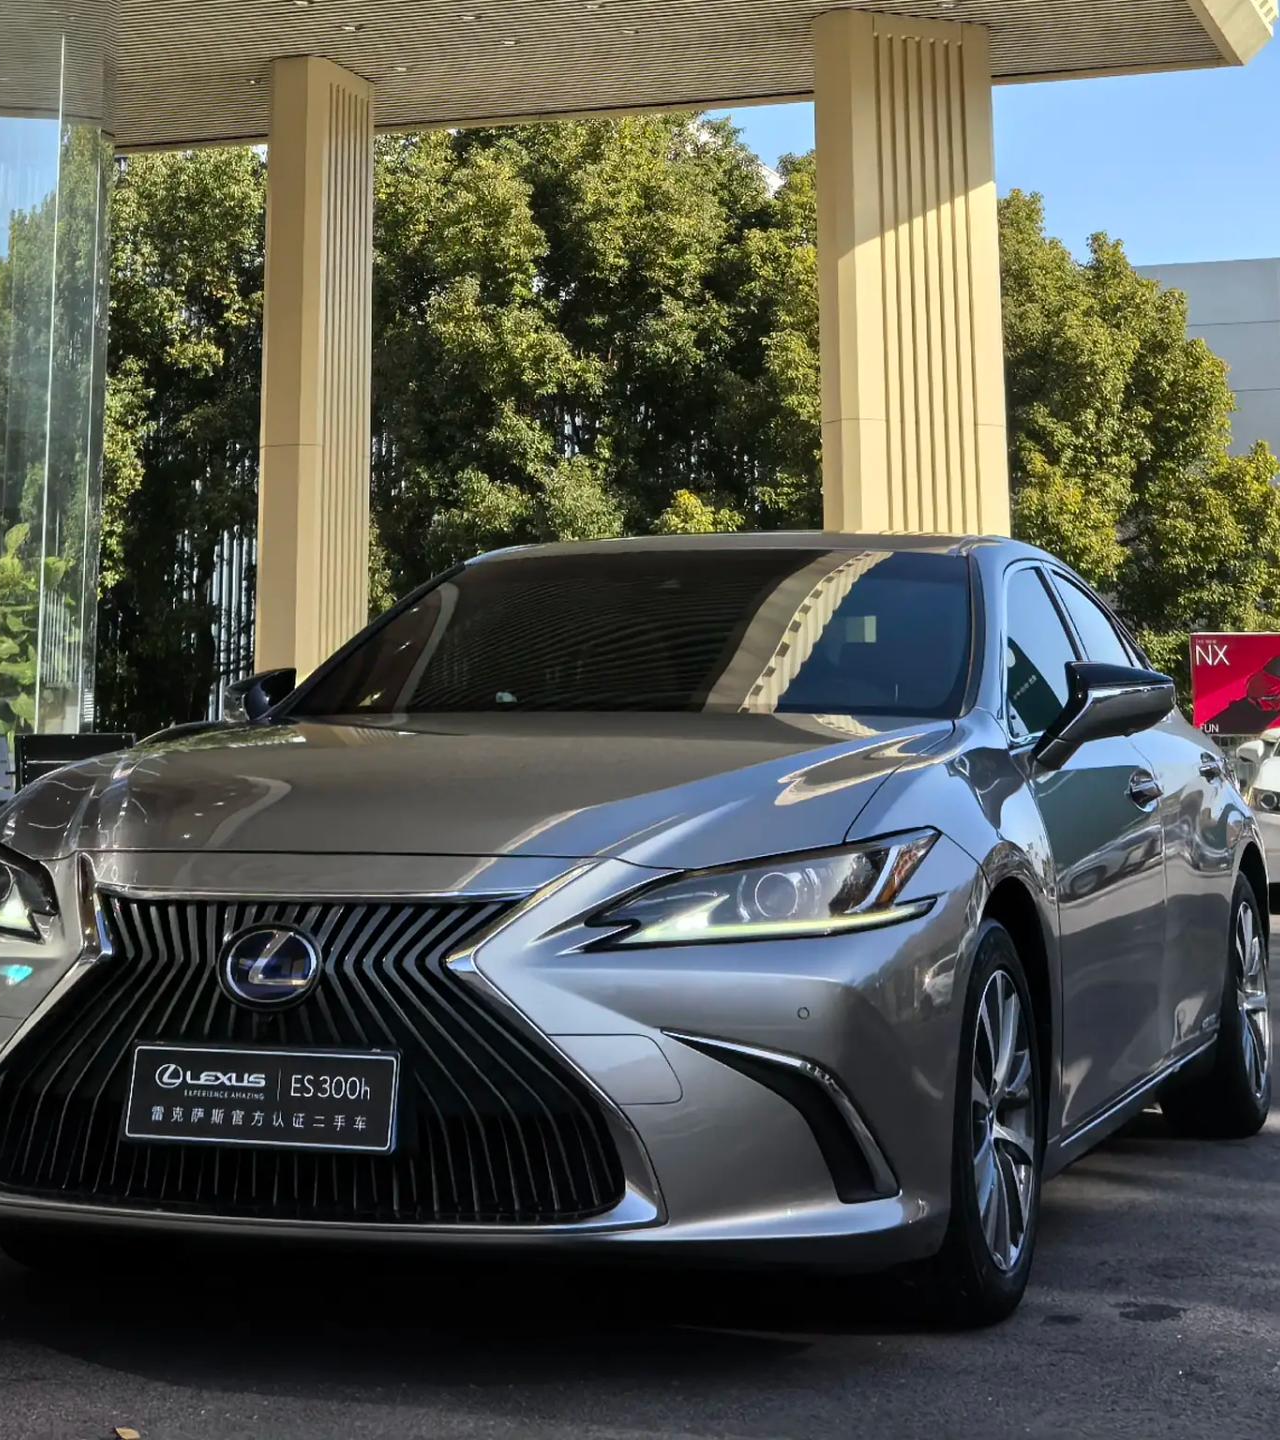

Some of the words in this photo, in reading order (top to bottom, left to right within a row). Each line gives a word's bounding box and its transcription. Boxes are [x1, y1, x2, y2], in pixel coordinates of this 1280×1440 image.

[1195, 644, 1230, 666] NX
[186, 1070, 266, 1087] LEXUS
[184, 1089, 228, 1099] EXPERIENCE
[230, 1091, 265, 1101] AMAZING
[151, 1105, 367, 1132] 雷克萨斯官方认证二手车
